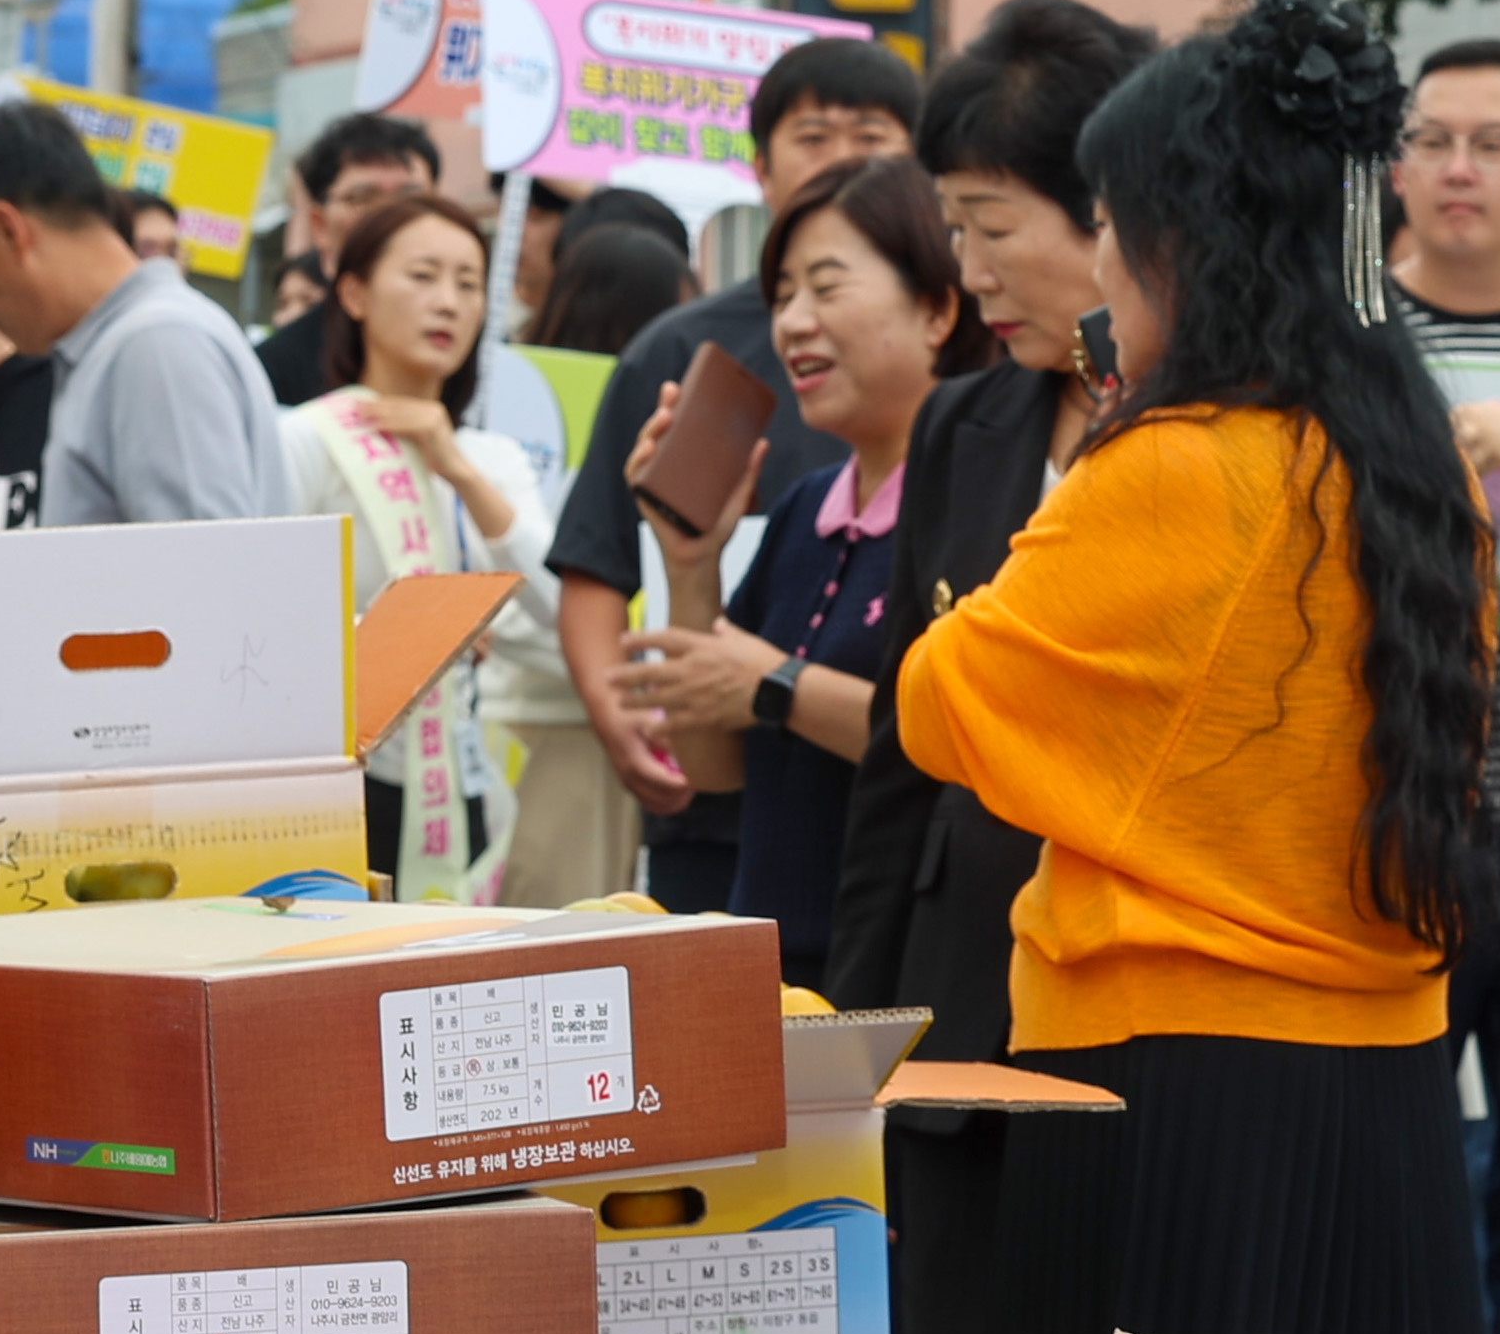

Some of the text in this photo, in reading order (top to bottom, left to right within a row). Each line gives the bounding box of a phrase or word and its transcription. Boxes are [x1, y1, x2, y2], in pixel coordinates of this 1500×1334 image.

[483, 1012, 501, 1025] 신고
[474, 1036, 493, 1050] 전남
[399, 1017, 419, 1112] 표시사항
[586, 1071, 611, 1103] 12
[480, 1109, 502, 1123] 202
[32, 1141, 58, 1160] NH
[392, 1137, 636, 1185] 신선도 유지를 위해 냉장보관 하십시오.
[701, 1265, 716, 1281] M
[739, 1263, 750, 1278] S
[236, 1274, 248, 1287] 배
[232, 1294, 253, 1308] 신고
[310, 1295, 399, 1312] 010-9624-9203
[220, 1314, 266, 1330] 전남 나주
[310, 1313, 339, 1328] 나주시
